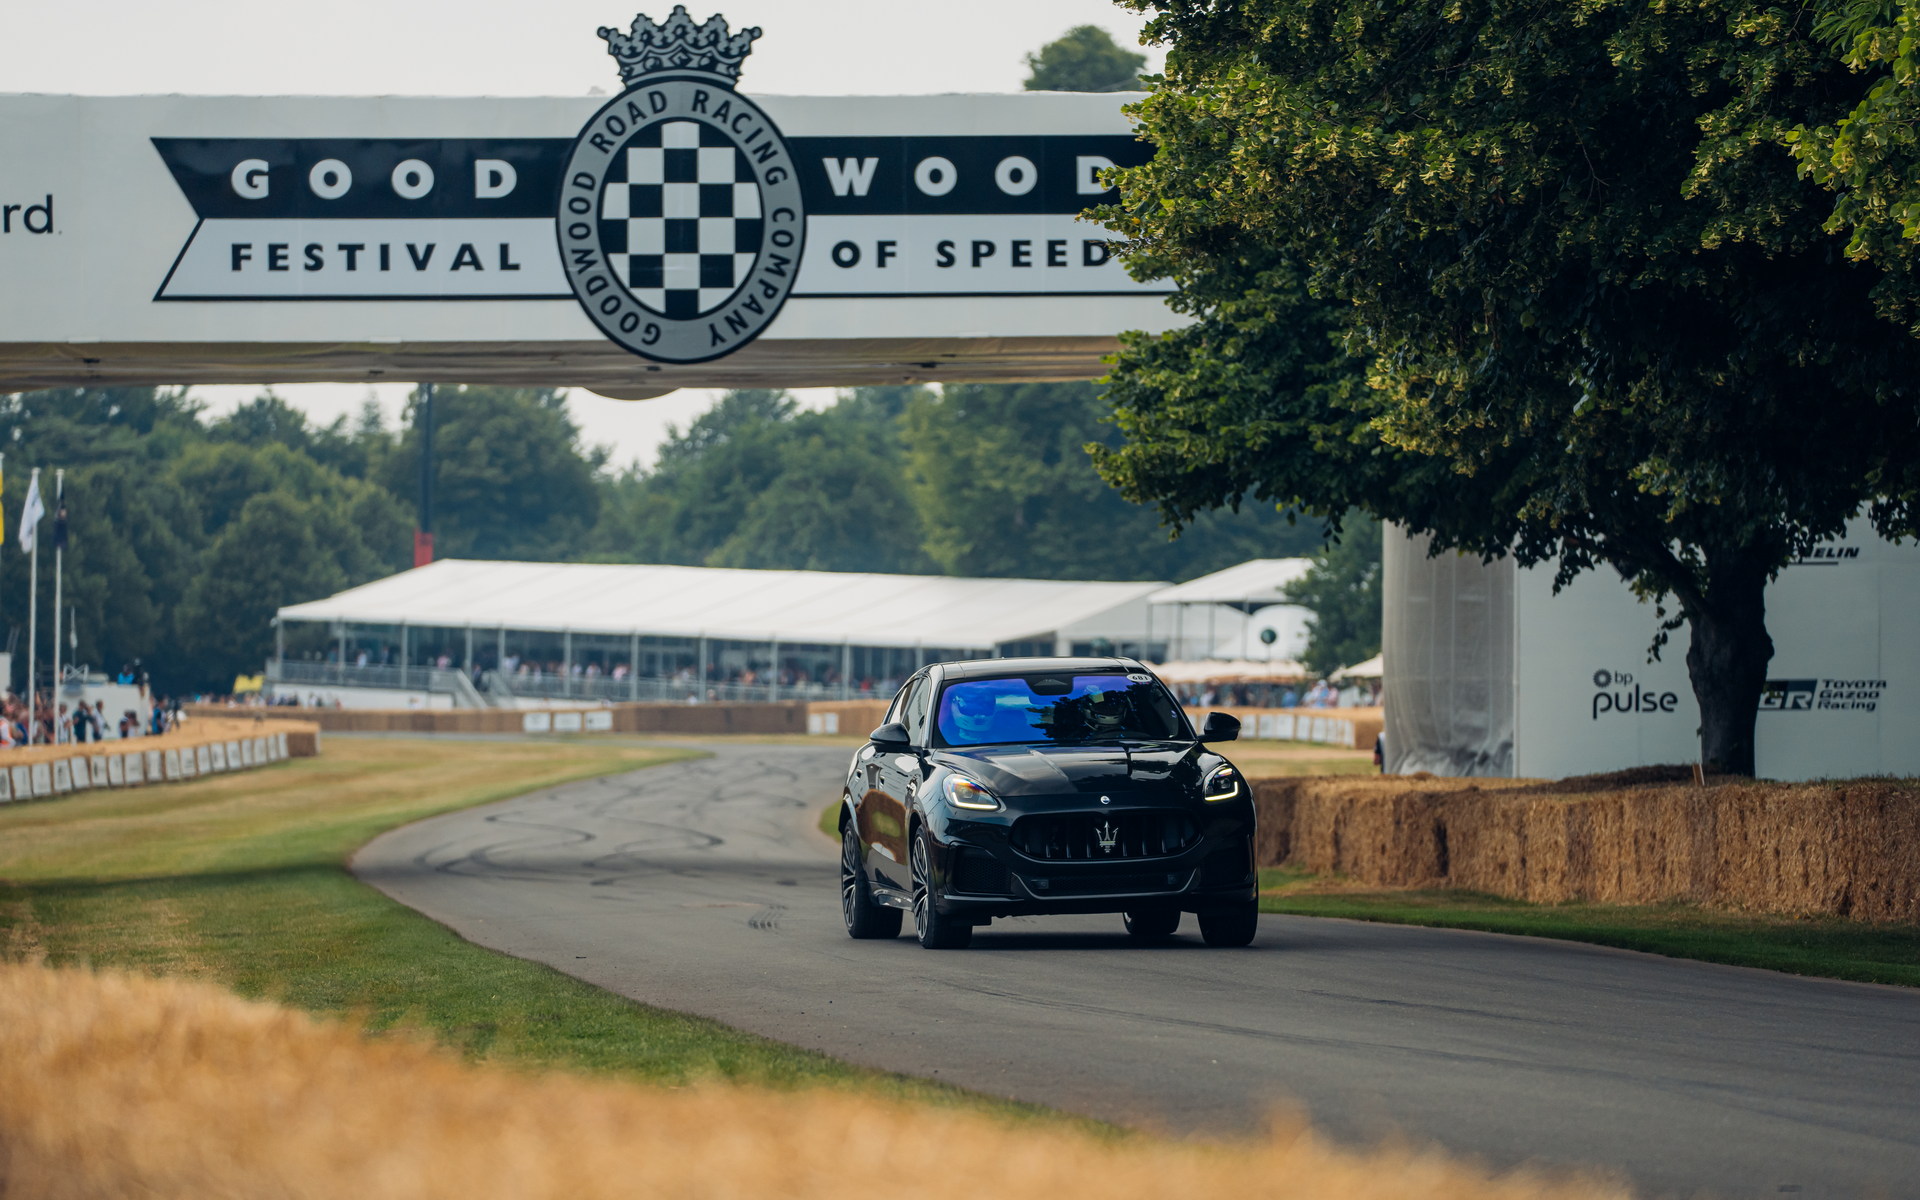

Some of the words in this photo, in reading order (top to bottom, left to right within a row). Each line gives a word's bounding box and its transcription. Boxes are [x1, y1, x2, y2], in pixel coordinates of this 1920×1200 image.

[589, 90, 668, 154] ROAD
[691, 89, 788, 186] RACING
[231, 158, 518, 200] GOOD
[822, 155, 1117, 197] WOOD
[230, 242, 522, 272] FESTIVAL
[831, 239, 898, 269] OF
[935, 239, 1111, 269] SPEED
[568, 171, 661, 346] GOODWOOD
[709, 207, 796, 347] COMPANY
[1803, 546, 1860, 559] ELIN
[1614, 670, 1633, 686] bp
[1818, 690, 1880, 699] GAZOO
[1822, 679, 1887, 690] TOYOTA
[1592, 682, 1679, 720] pulse
[1758, 690, 1813, 709] GR
[1817, 699, 1876, 712] Racing
